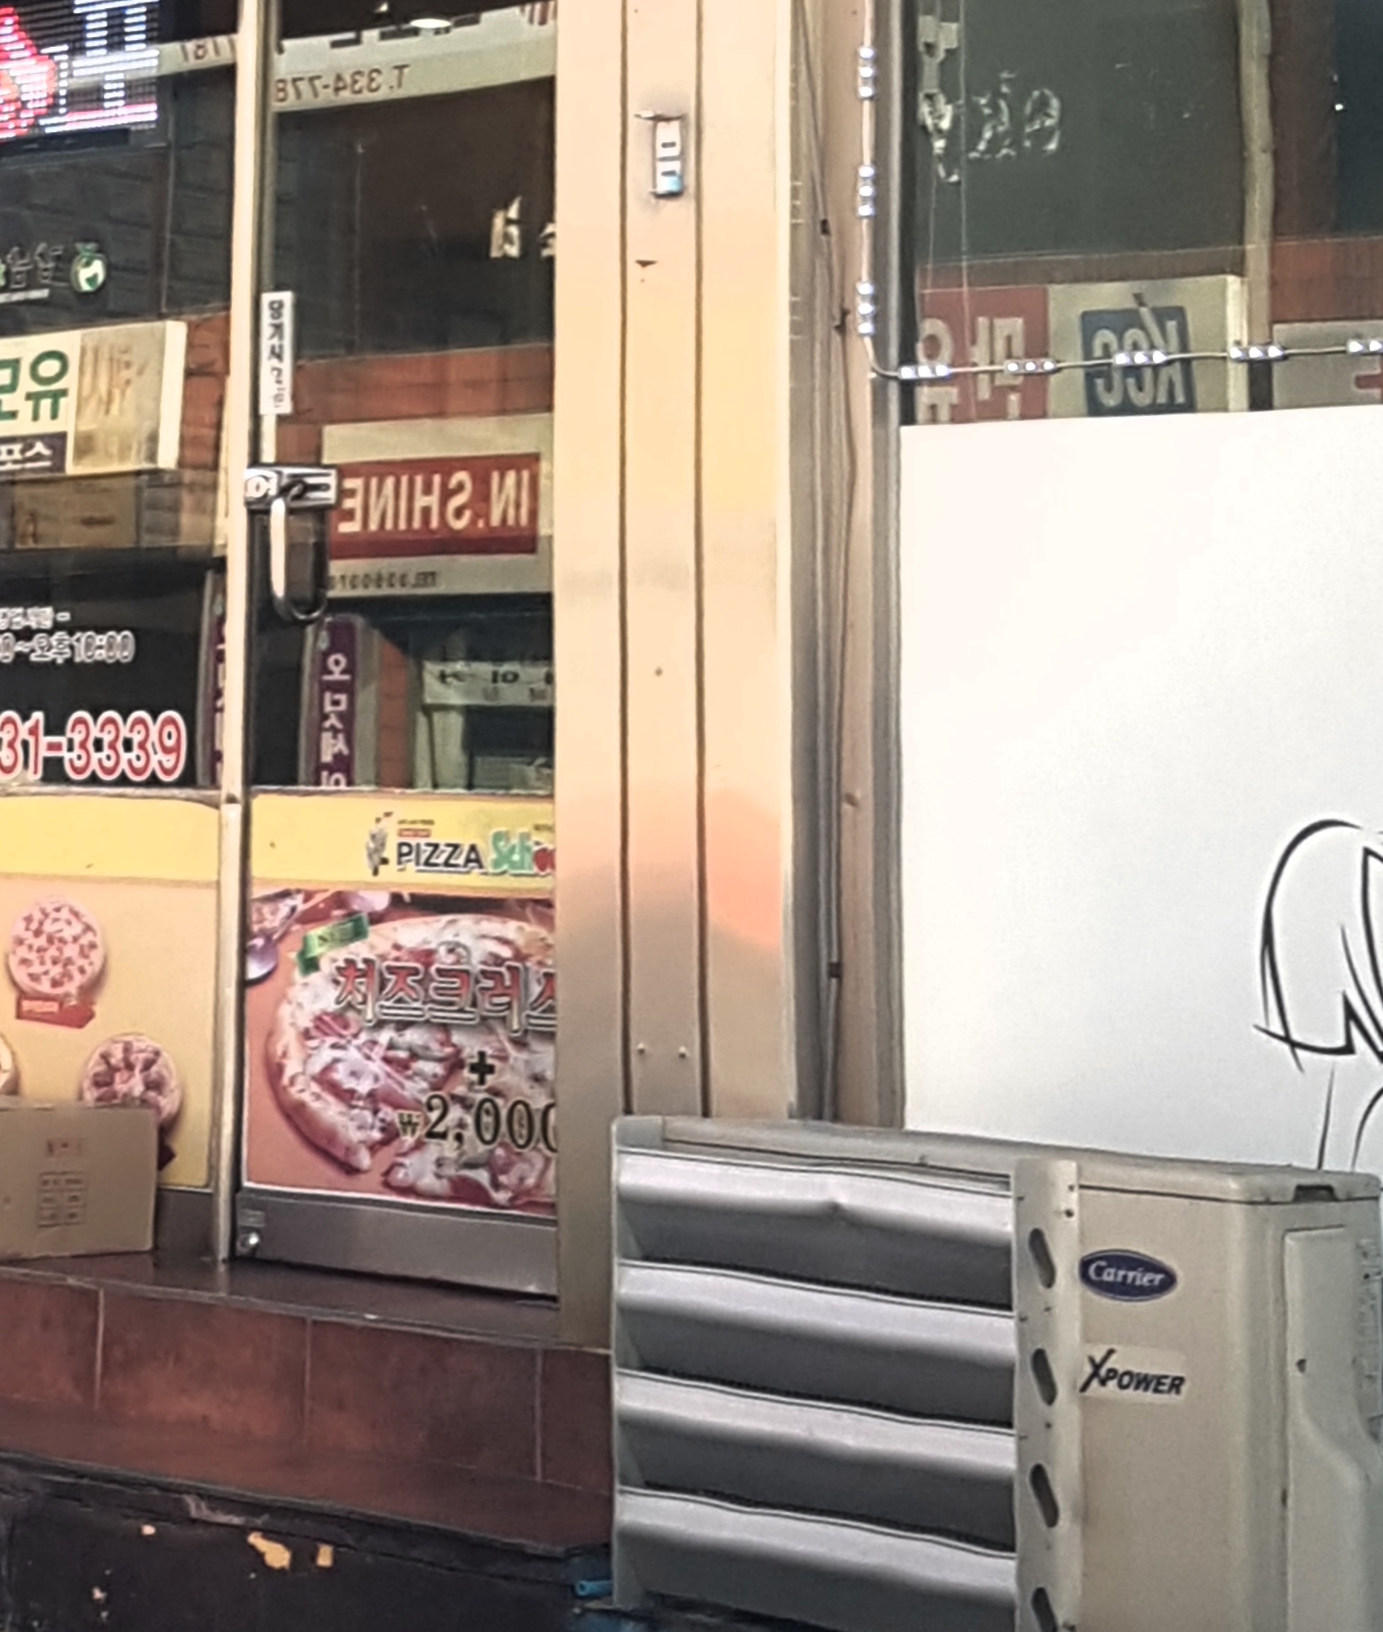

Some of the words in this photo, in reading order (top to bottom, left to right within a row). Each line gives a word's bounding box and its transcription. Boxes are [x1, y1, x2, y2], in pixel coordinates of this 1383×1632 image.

[395, 841, 486, 870] PIZZA
[1088, 1259, 1165, 1287] Carrier
[1079, 1347, 1187, 1397] XPOWER
